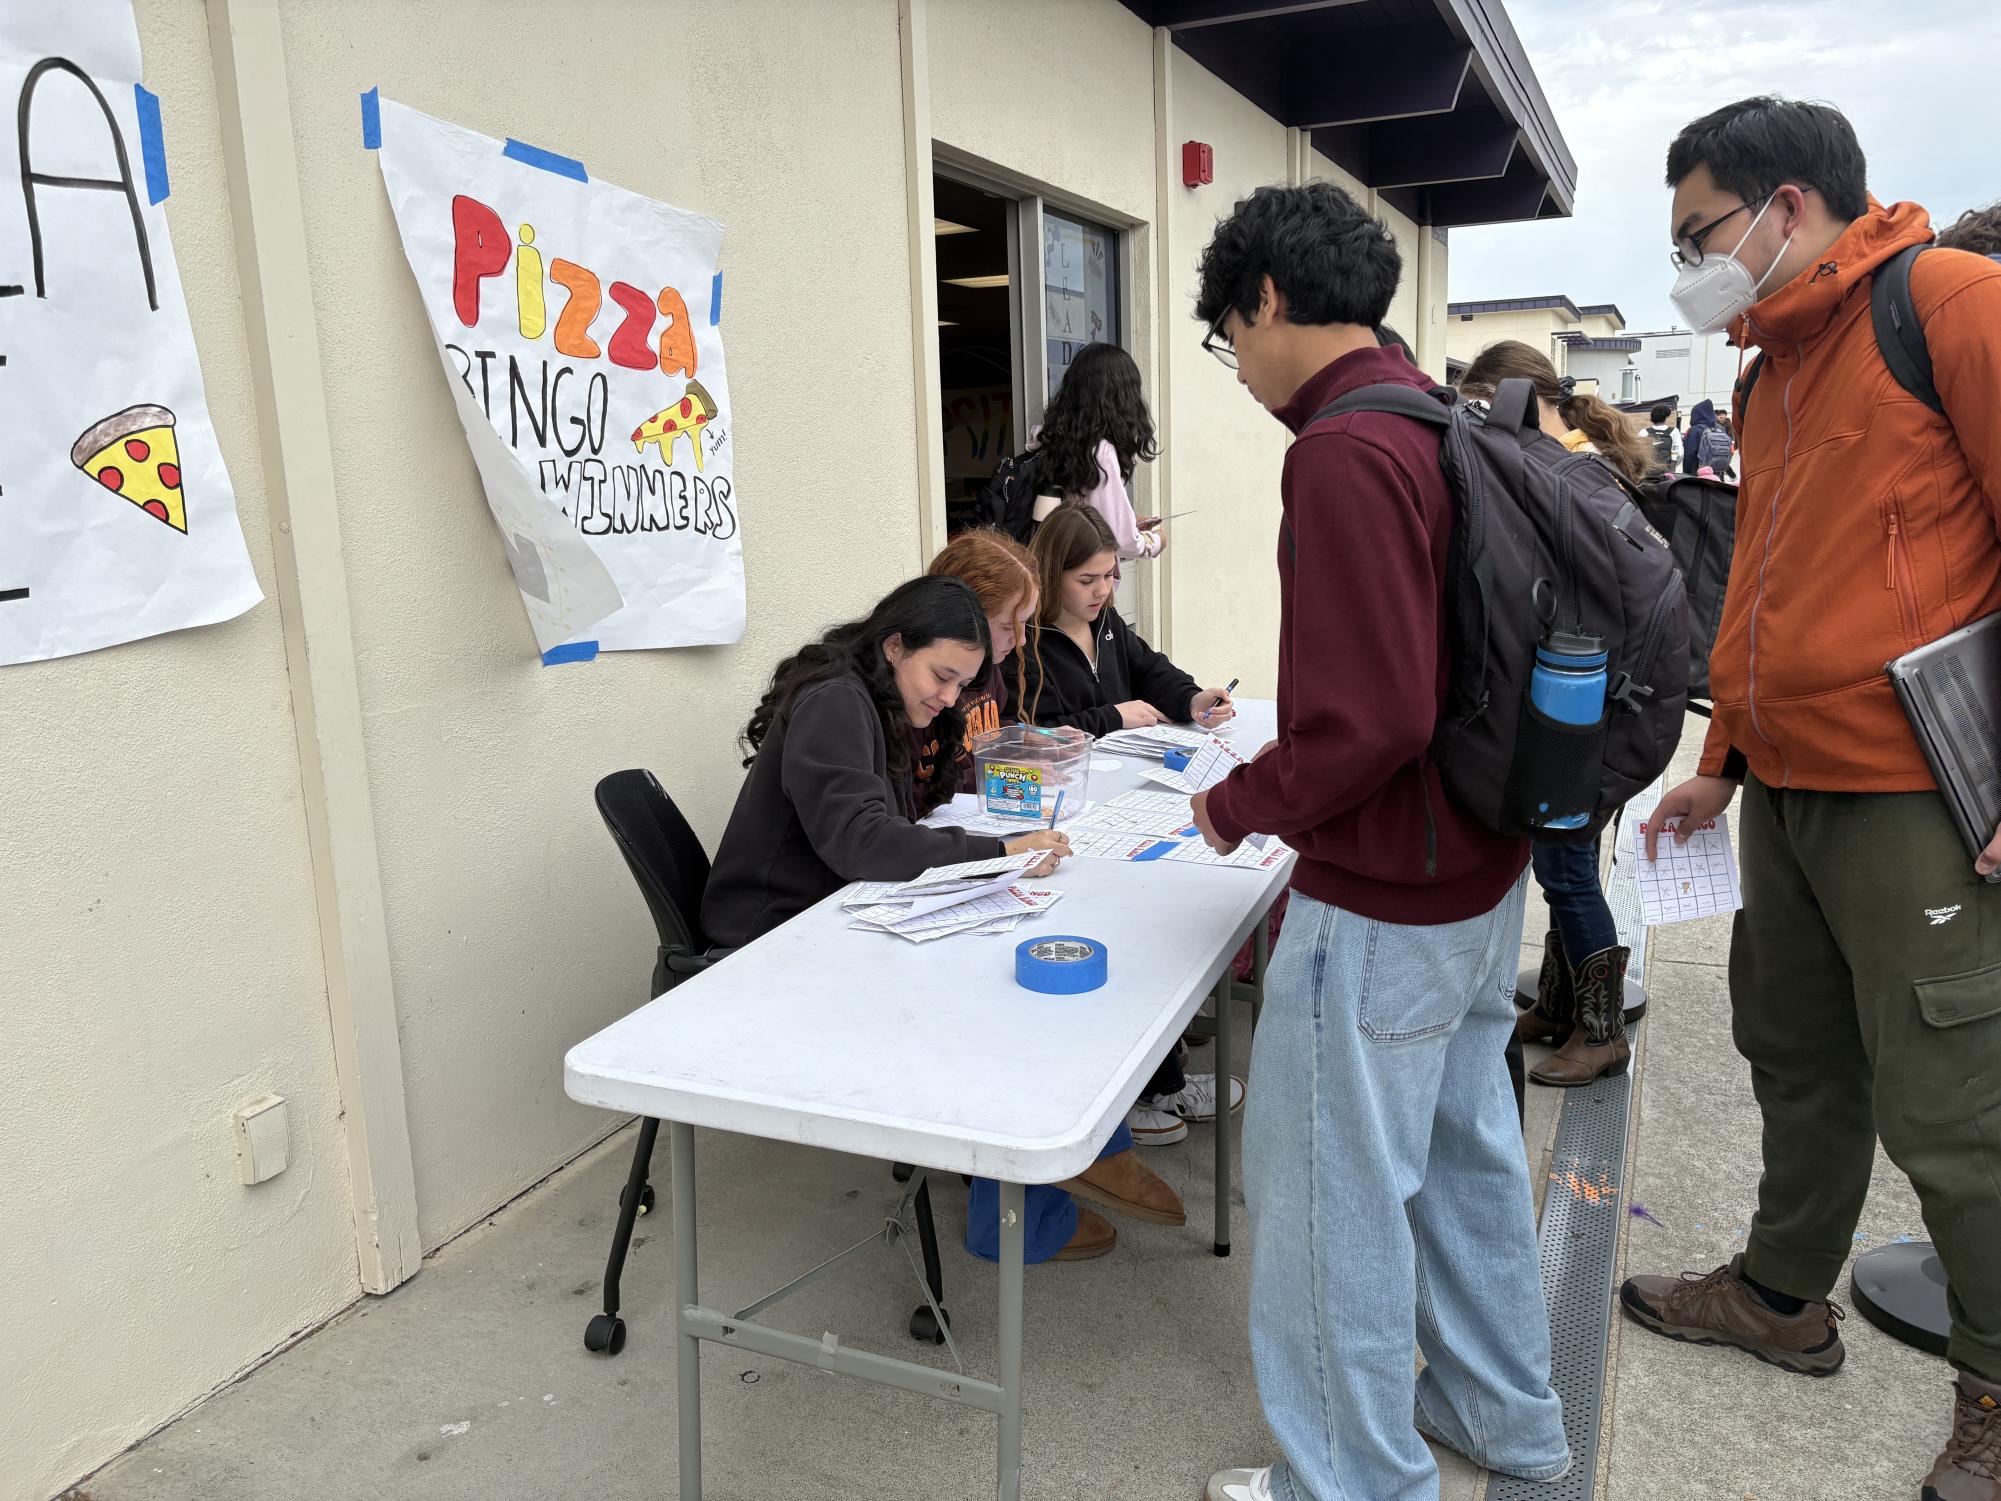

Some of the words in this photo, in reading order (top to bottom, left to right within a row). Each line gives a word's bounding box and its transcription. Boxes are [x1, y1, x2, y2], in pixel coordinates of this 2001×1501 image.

[0, 57, 160, 311] A
[539, 458, 736, 540] WINNERS
[999, 771, 1026, 783] PUNCH
[1639, 822, 1676, 834] PZA
[1925, 904, 1962, 916] Reebok
